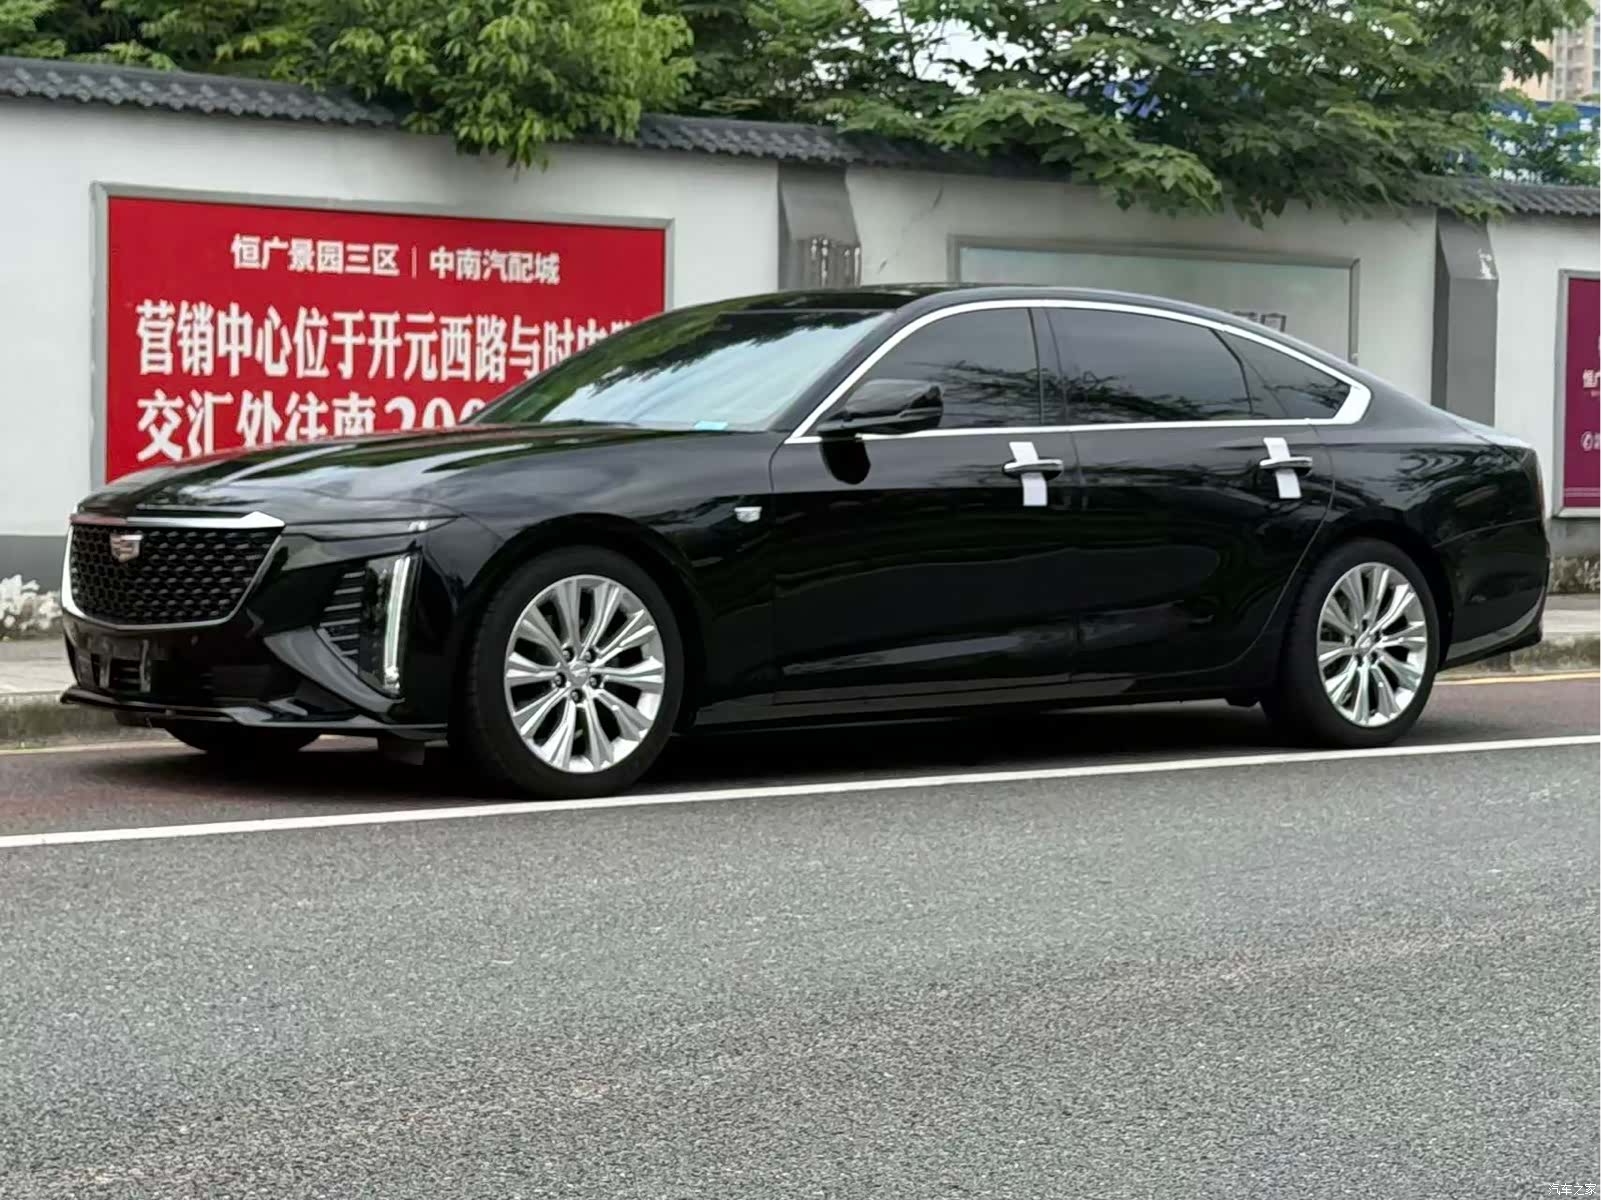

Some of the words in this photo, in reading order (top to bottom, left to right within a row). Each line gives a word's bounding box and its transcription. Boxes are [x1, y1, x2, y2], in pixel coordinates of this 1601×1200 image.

[231, 234, 400, 276] 恒广景园三区
[429, 245, 560, 285] 中南汽配城
[136, 299, 633, 382] 营销中心位于开元西路与时
